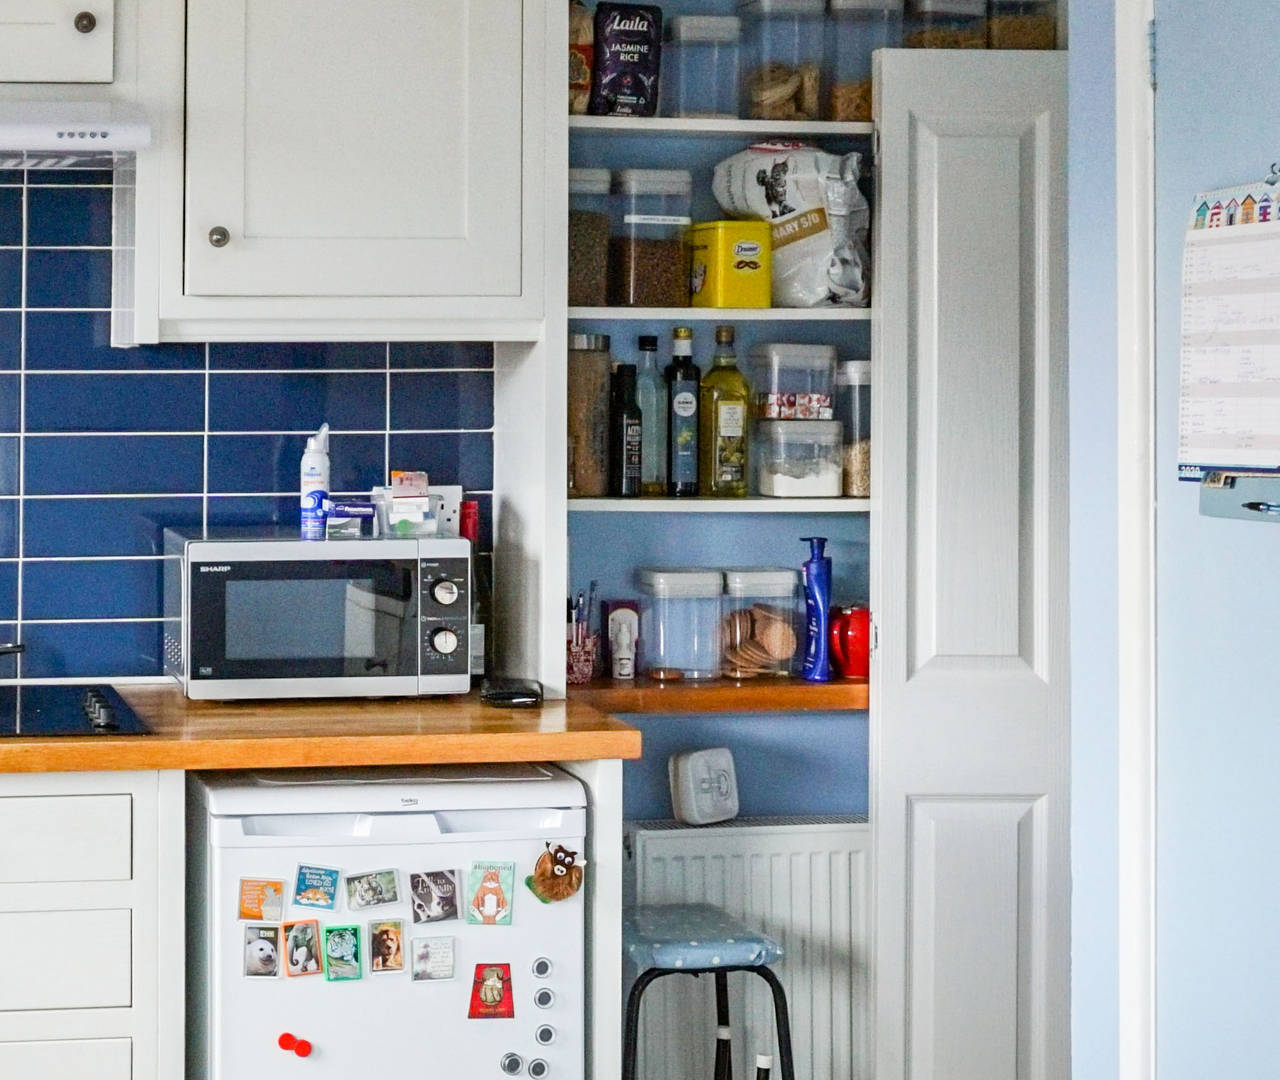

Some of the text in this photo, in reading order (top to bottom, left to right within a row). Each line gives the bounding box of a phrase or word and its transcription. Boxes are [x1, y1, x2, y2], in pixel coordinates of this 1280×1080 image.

[613, 14, 648, 31] Laila
[611, 43, 648, 53] JASMINE
[619, 53, 639, 62] RICE
